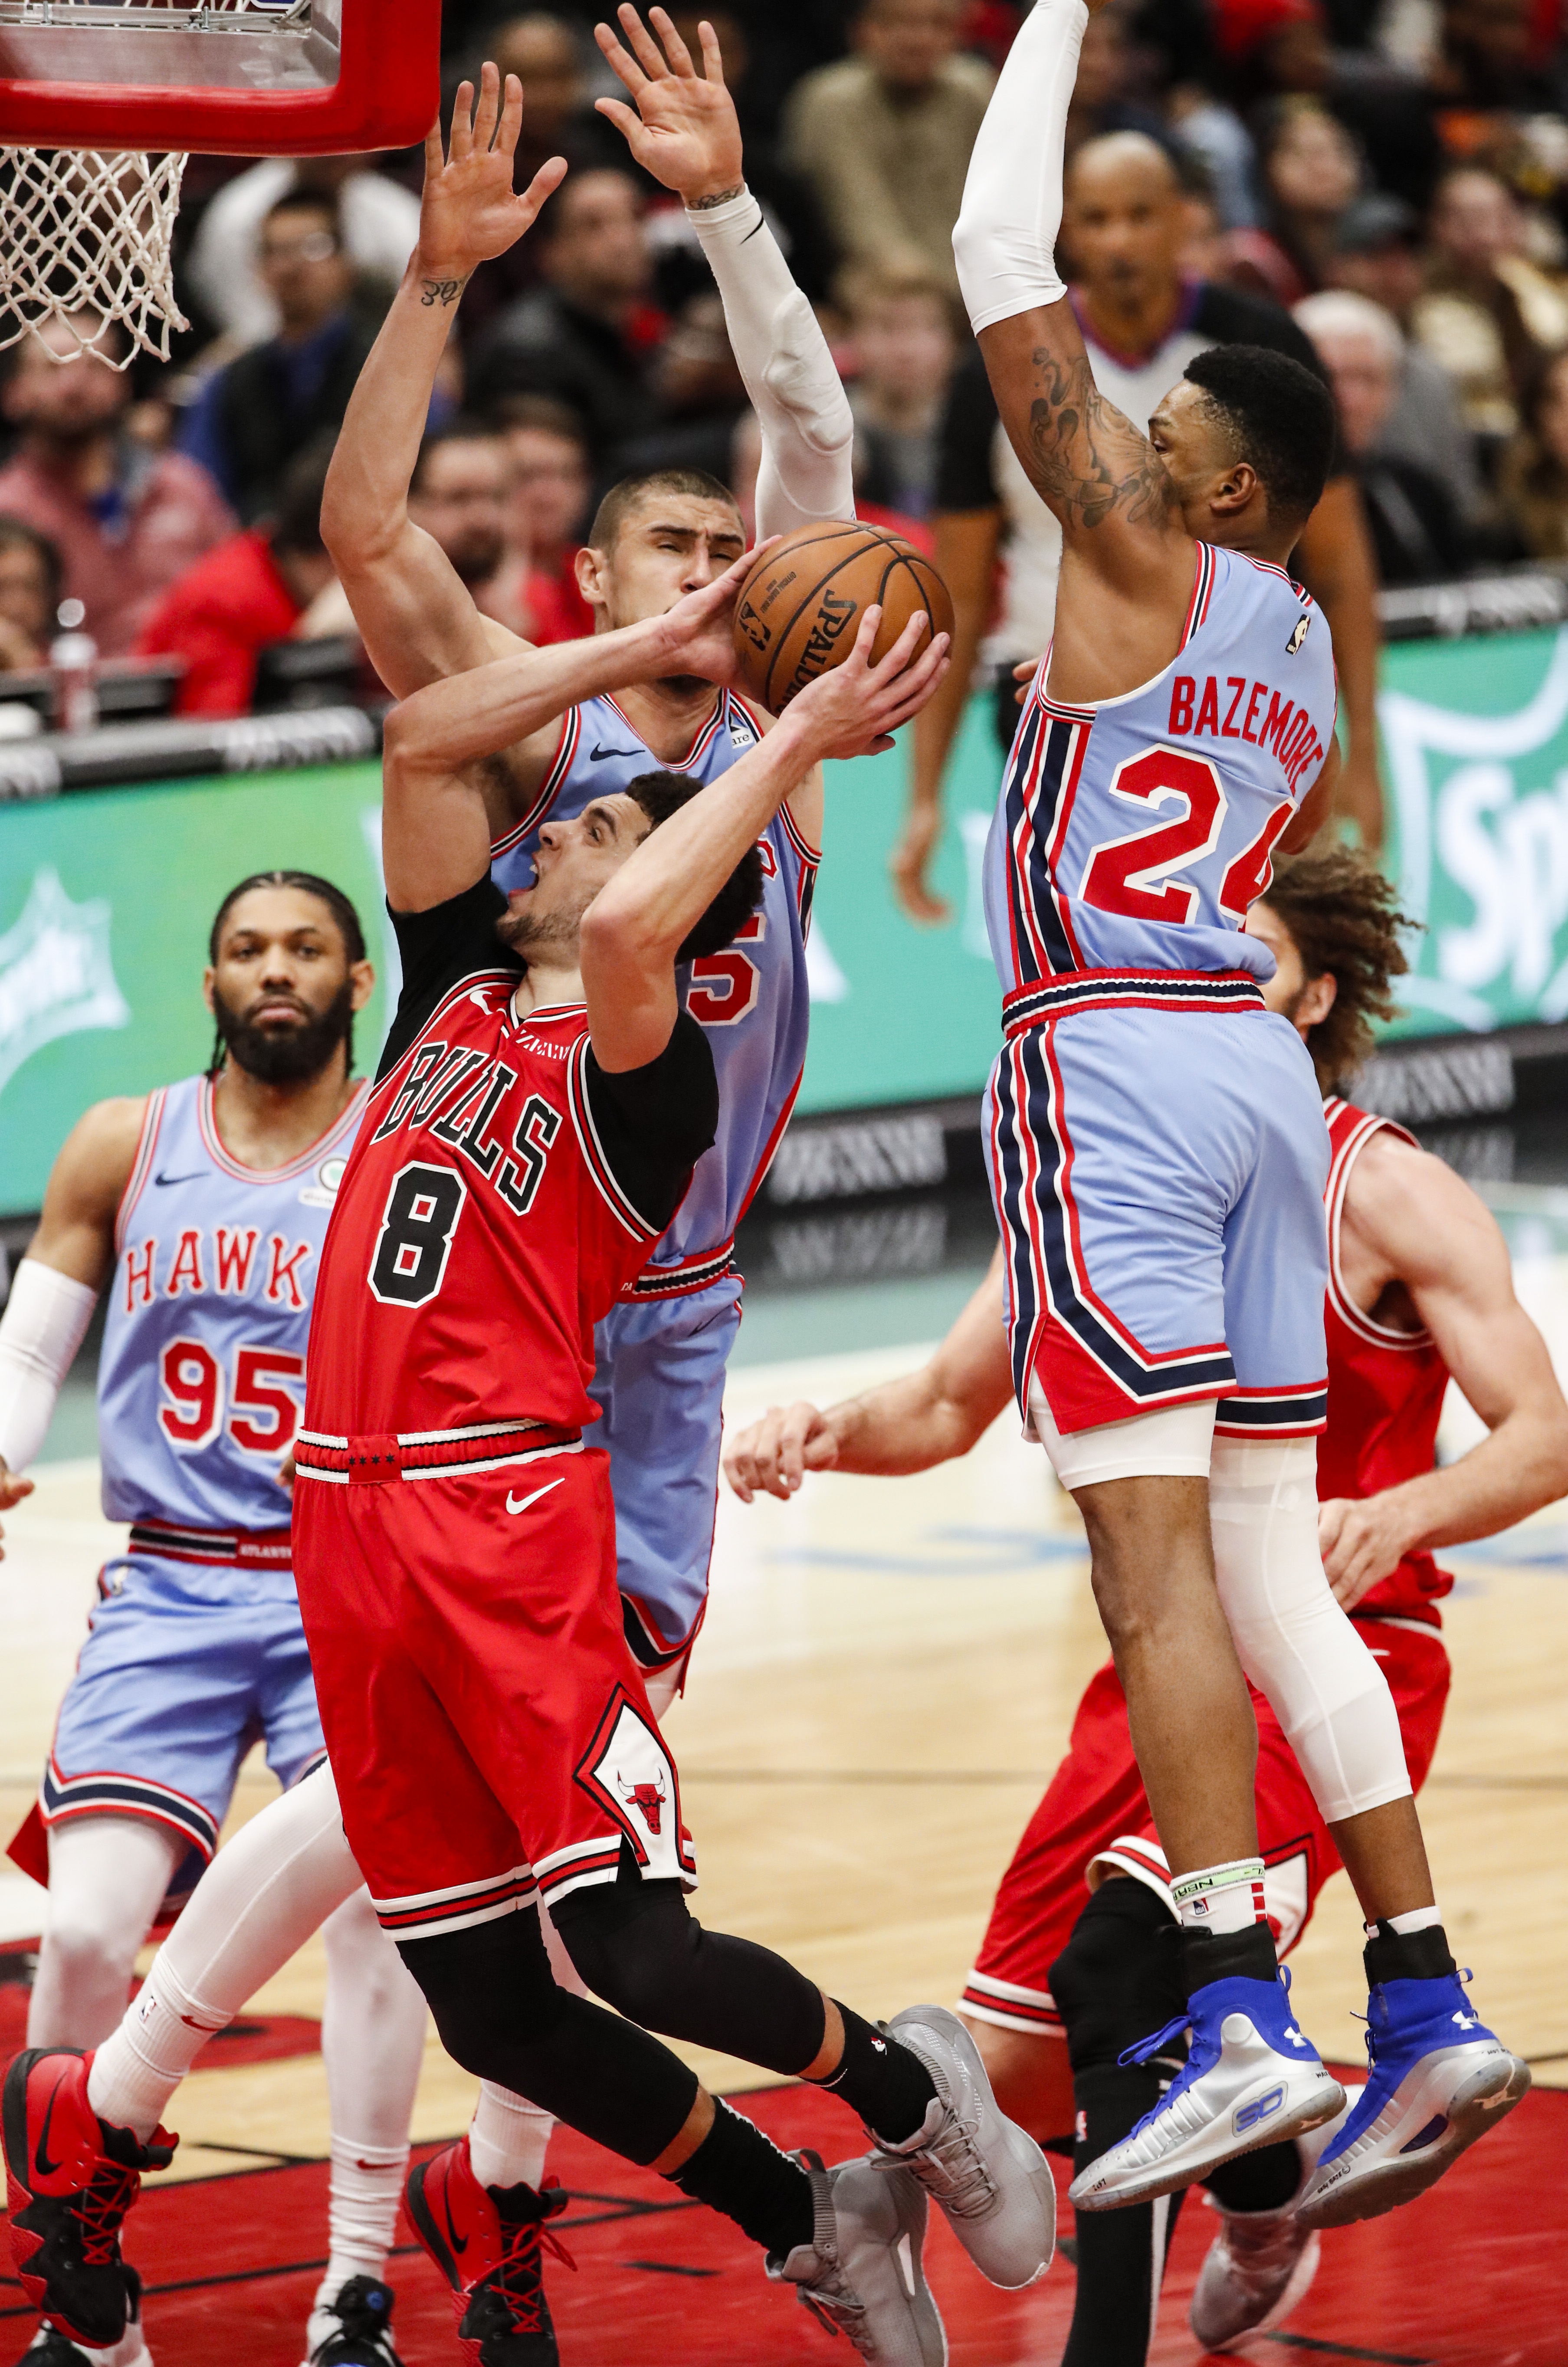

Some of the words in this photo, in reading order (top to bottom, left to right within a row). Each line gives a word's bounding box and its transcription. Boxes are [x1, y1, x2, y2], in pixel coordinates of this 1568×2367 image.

[1168, 676, 1323, 798] BAZEMORE
[1077, 742, 1299, 933] 24
[370, 1041, 563, 1216] BULLS
[125, 1226, 318, 1315] HAWK
[367, 1160, 467, 1309] 8
[157, 1335, 306, 1460] 95
[1196, 1906, 1205, 1914] NBA
